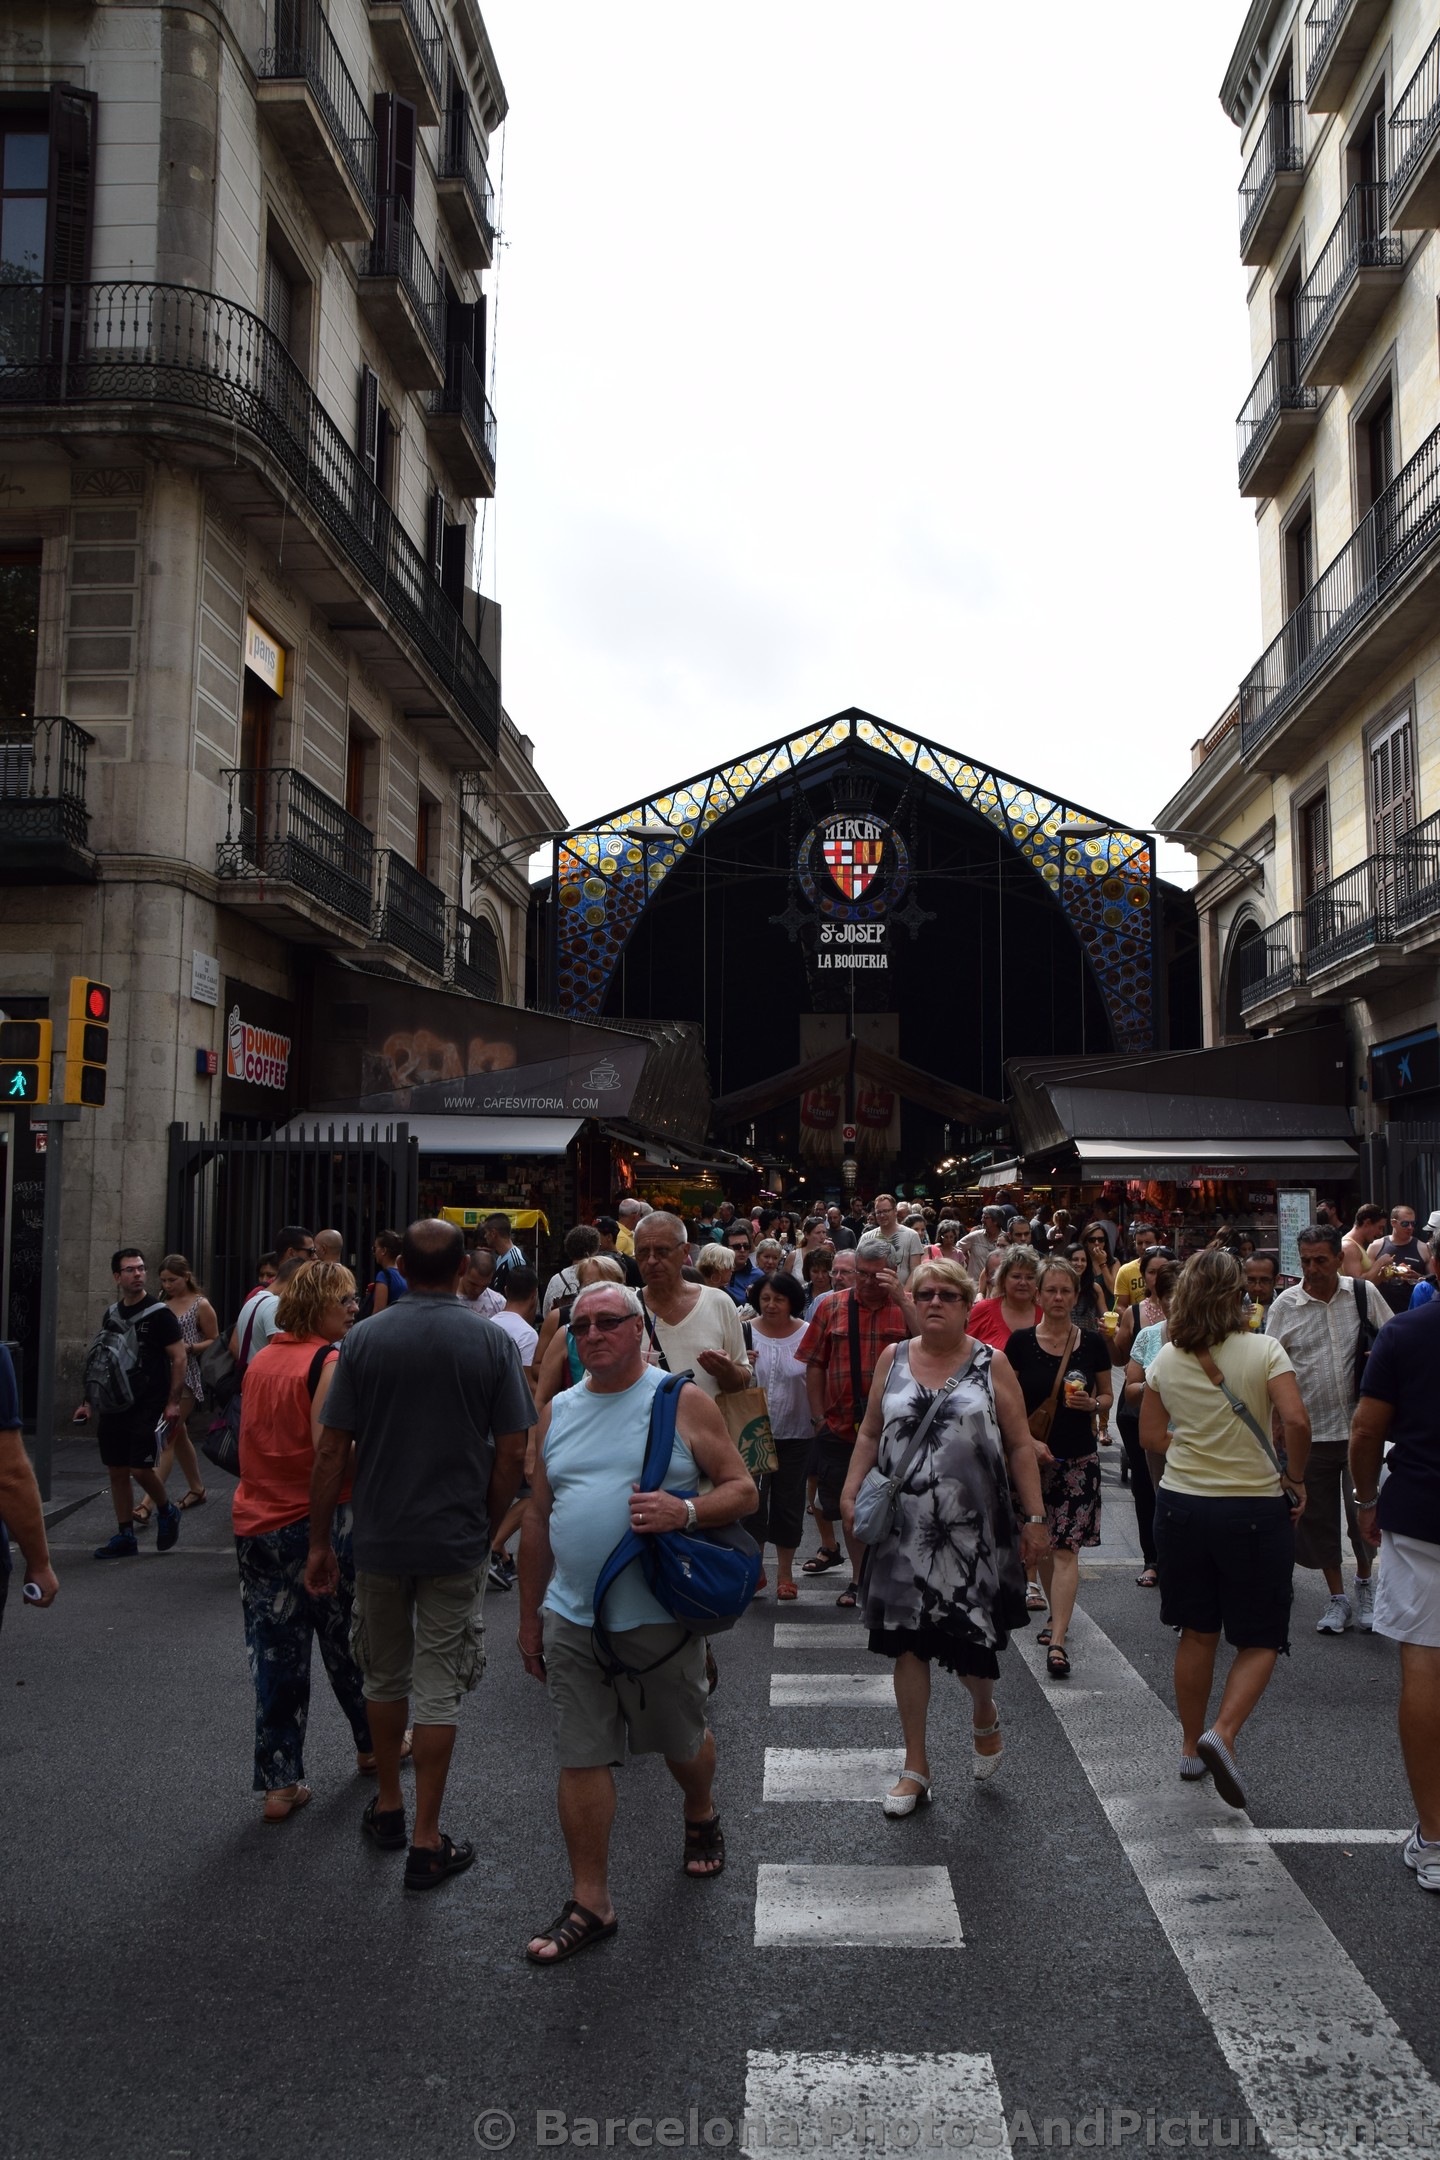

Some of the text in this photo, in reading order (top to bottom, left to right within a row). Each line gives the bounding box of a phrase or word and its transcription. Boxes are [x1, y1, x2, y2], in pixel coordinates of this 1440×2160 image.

[254, 633, 276, 669] pans
[824, 819, 882, 840] MERCAT
[835, 923, 886, 943] JOSEP
[817, 954, 888, 969] LA BOQUERIA
[246, 1027, 290, 1062] DUNKIN'
[245, 1053, 286, 1087] COFFEE
[806, 1104, 835, 1117] Estrella
[862, 1103, 889, 1115] Estrella
[846, 1127, 853, 1138] 6
[1191, 1165, 1236, 1177] Marcos
[1254, 1193, 1268, 1204] 69
